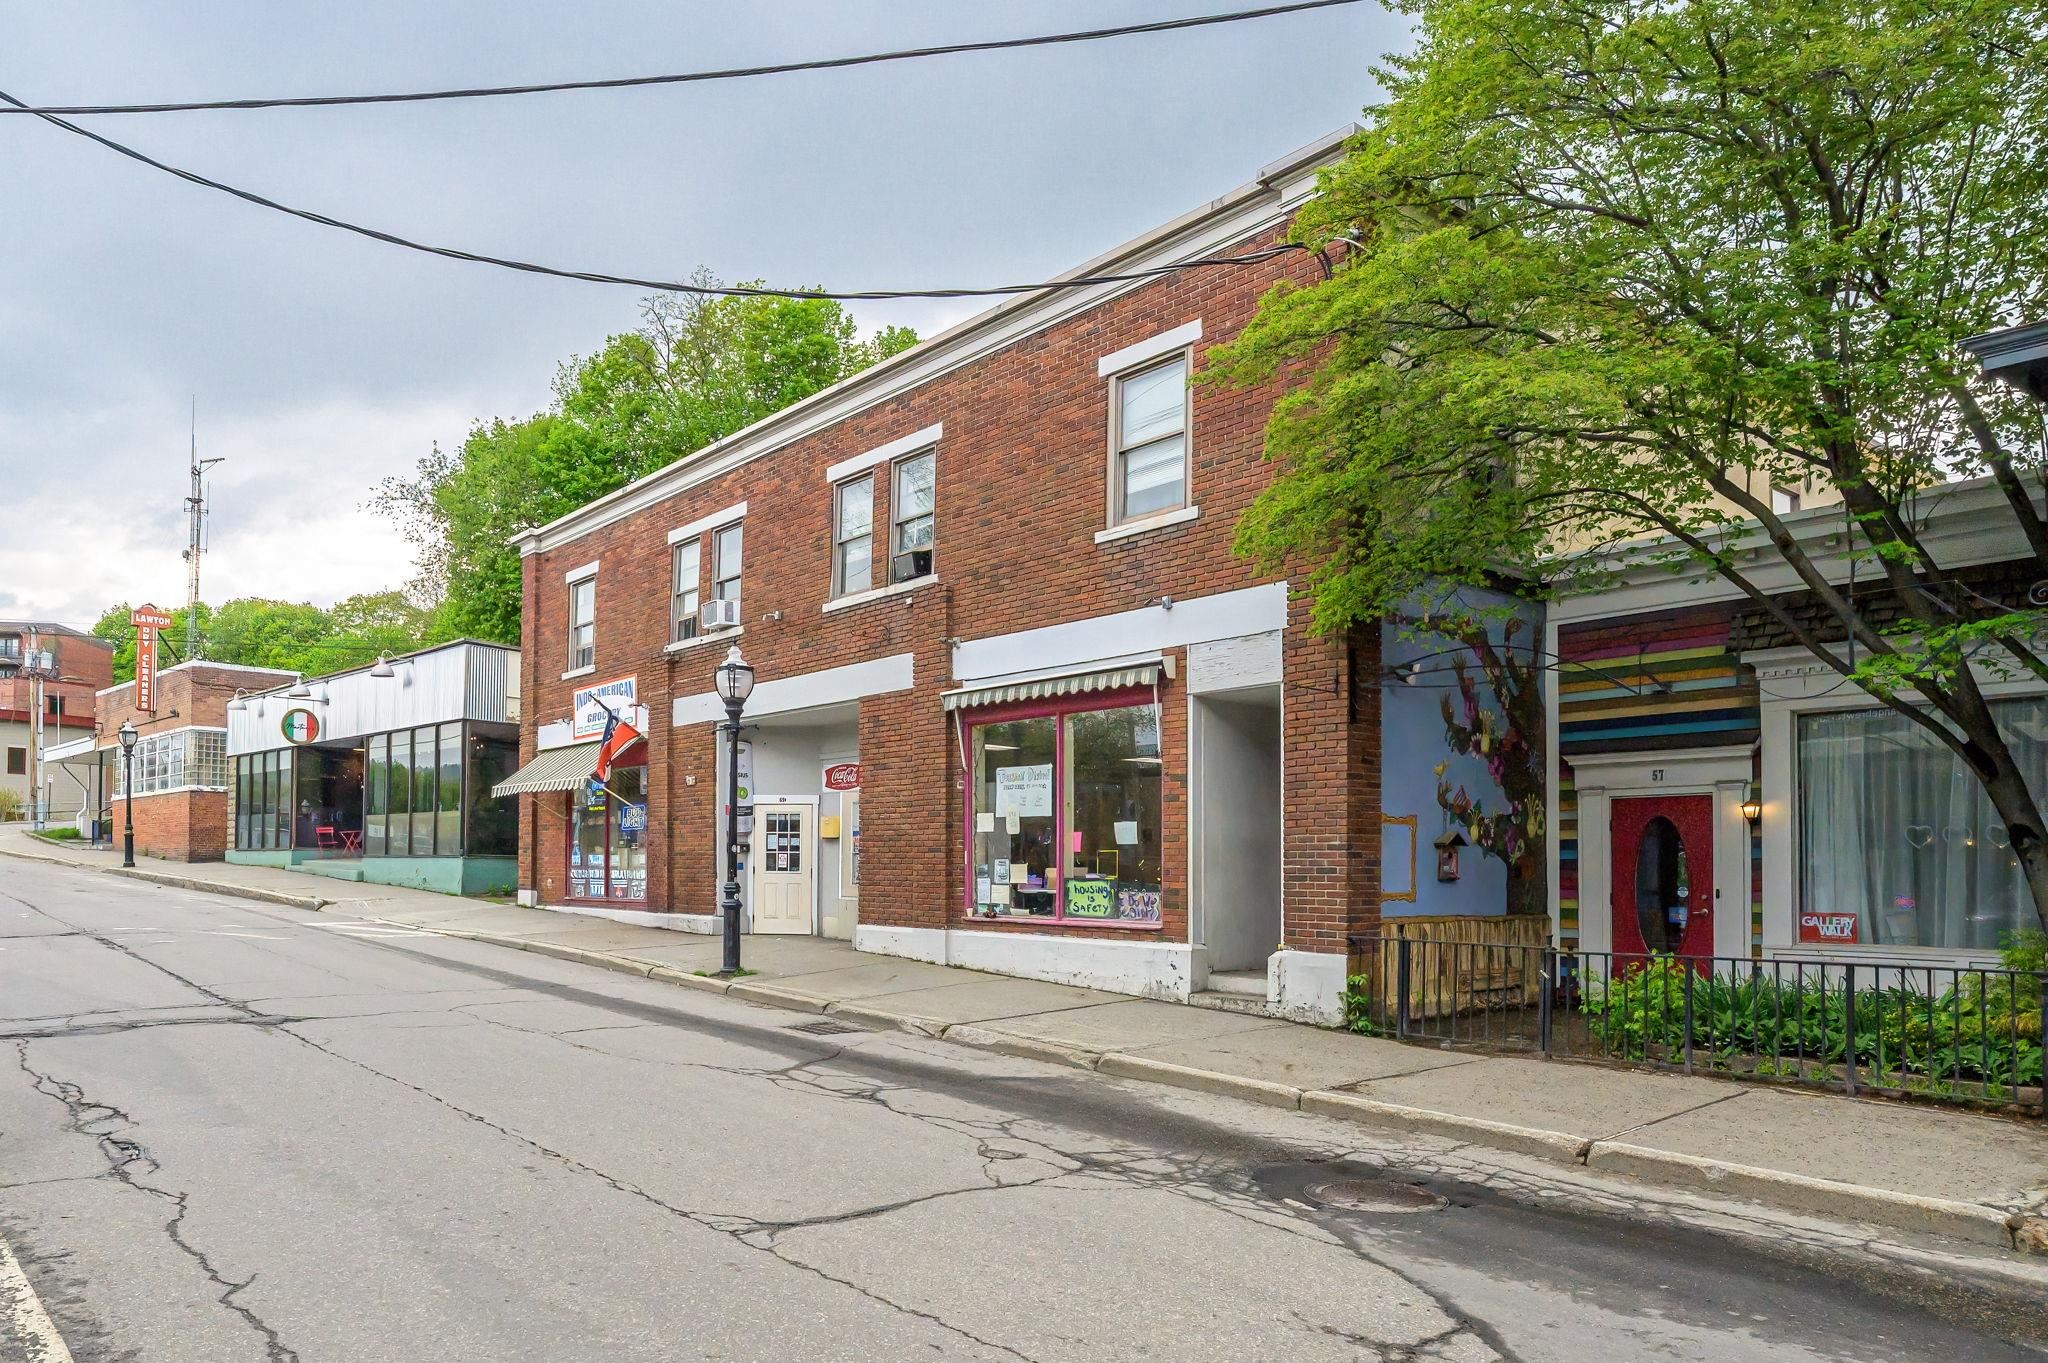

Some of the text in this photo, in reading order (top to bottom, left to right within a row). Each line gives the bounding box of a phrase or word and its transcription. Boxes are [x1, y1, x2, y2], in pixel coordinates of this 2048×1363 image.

[135, 614, 171, 625] LAWTON
[141, 626, 150, 709] DRY CLEANERS
[576, 680, 634, 711] INDO-AMERICAN
[587, 707, 621, 723] GROCRY
[1652, 769, 1664, 781] 57
[627, 808, 641, 818] BUD
[623, 816, 643, 827] LIGHT
[1801, 916, 1855, 928] GALLERY
[1818, 925, 1853, 937] WALK
